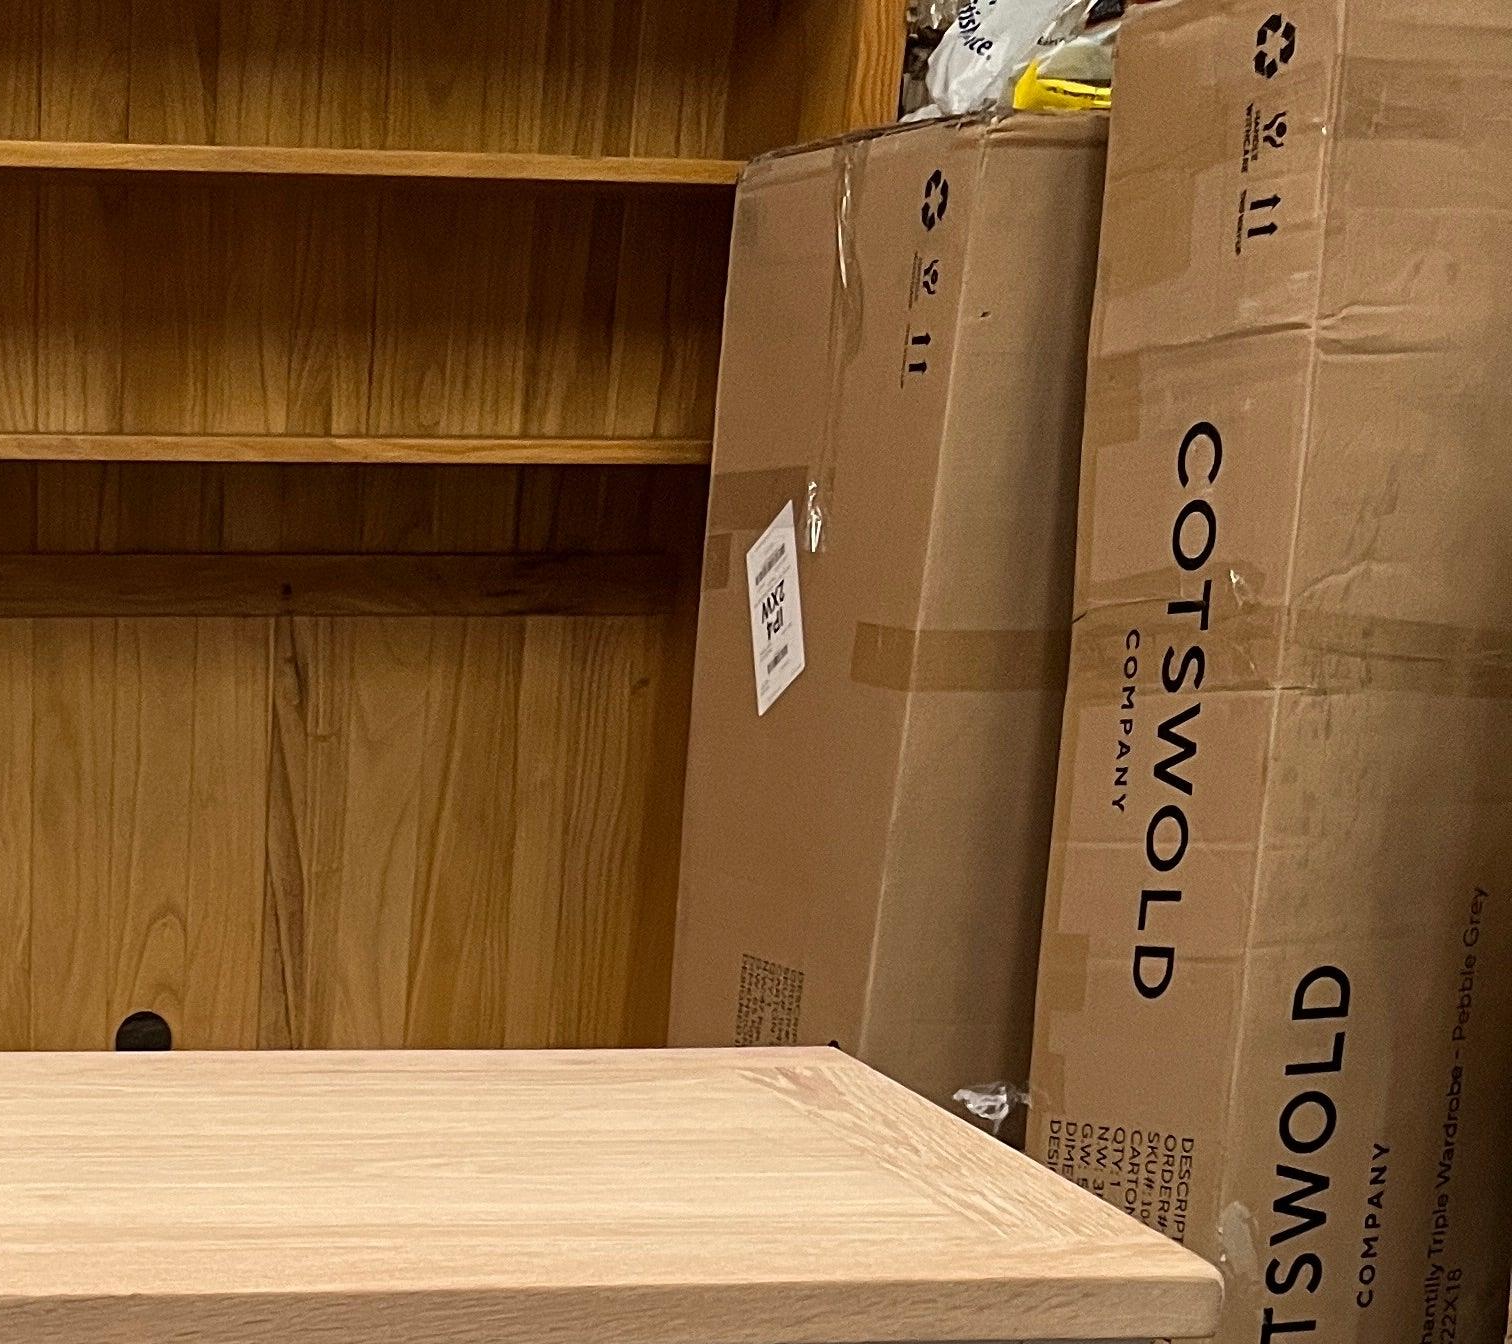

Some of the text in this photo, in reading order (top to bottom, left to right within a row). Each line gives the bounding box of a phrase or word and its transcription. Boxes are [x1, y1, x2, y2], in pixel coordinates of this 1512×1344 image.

[1111, 629, 1140, 813] COMPANY
[1133, 421, 1222, 999] COTSWOLD
[1463, 886, 1489, 947] Grey
[1452, 954, 1476, 1042] Pebble
[1061, 1121, 1078, 1181] DIME
[1434, 1065, 1463, 1189] Wardrobe
[1356, 1142, 1391, 1309] COMPANY
[1427, 1193, 1450, 1259] Triple
